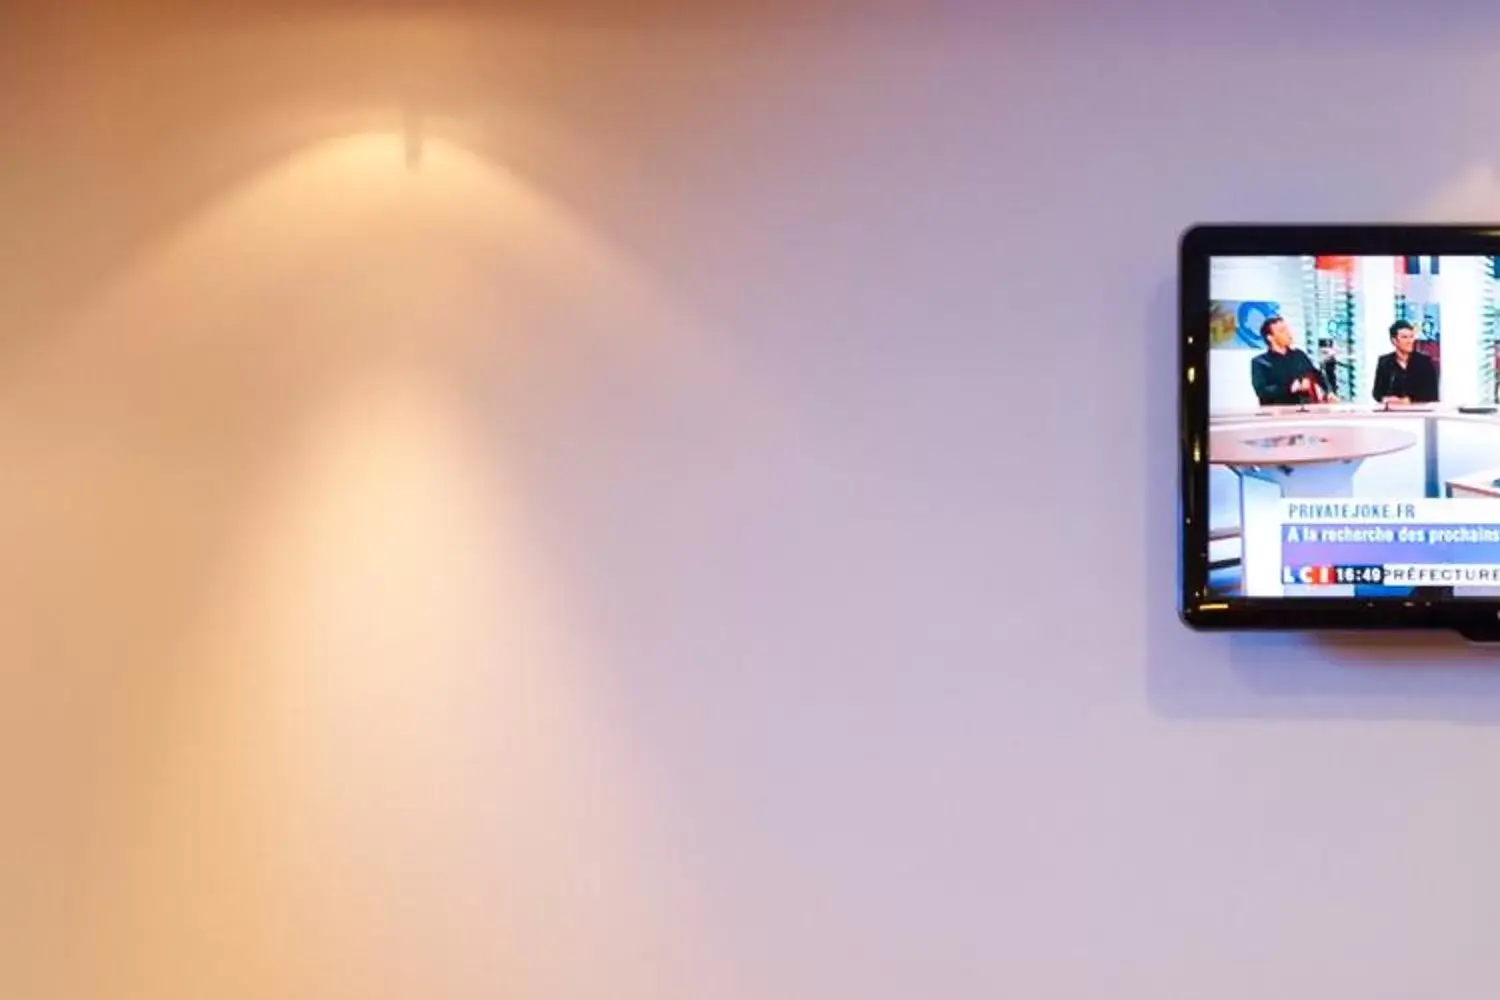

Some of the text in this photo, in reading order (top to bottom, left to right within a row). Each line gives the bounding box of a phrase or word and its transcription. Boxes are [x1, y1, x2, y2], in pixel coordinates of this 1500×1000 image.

[1288, 503, 1416, 519] PRIVATEJOKE.FR
[1287, 527, 1300, 542] A
[1302, 527, 1318, 542] la
[1321, 526, 1394, 543] recherche
[1398, 527, 1426, 542] des
[1429, 527, 1500, 544] prochains
[1336, 567, 1382, 583] 16:49
